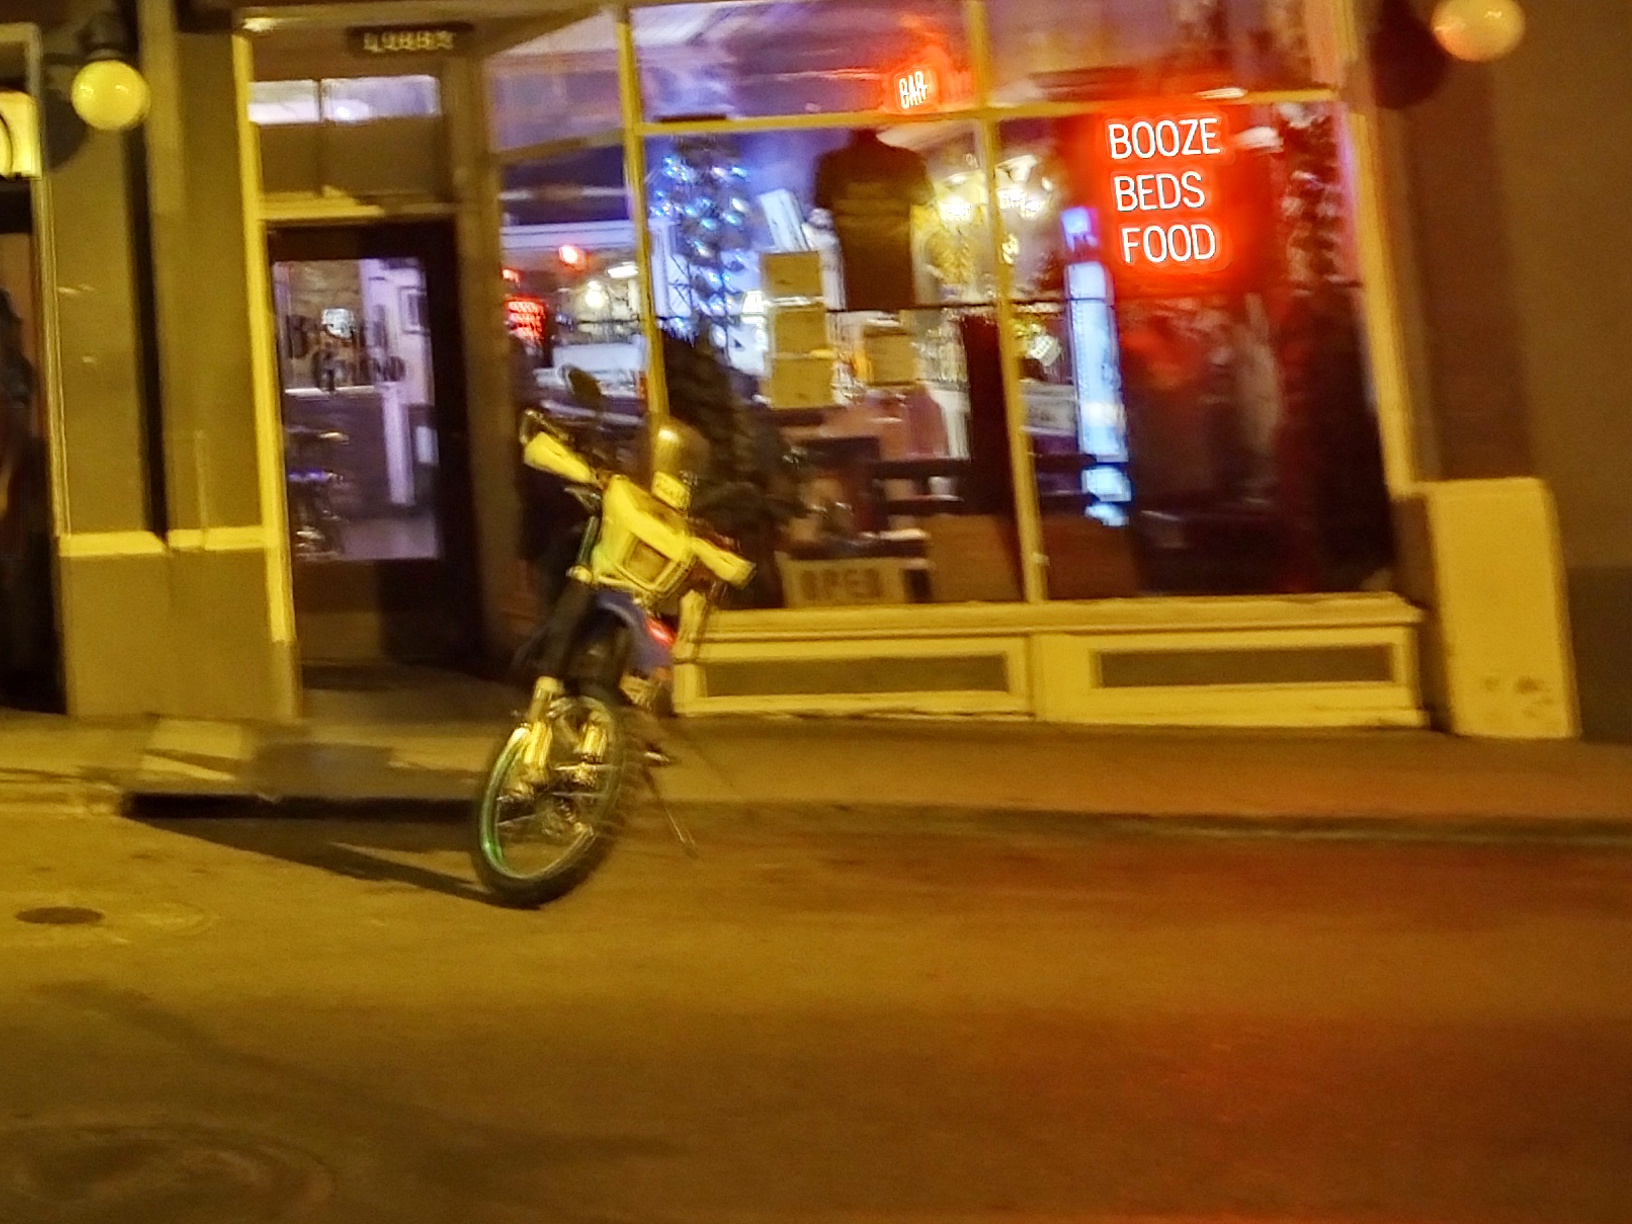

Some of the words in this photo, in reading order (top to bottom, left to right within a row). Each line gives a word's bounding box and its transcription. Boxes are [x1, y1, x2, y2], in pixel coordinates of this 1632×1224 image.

[898, 70, 929, 109] BAR
[1107, 117, 1223, 160] BOOZE
[1113, 171, 1207, 213] BEDS
[1121, 223, 1218, 264] FOOD
